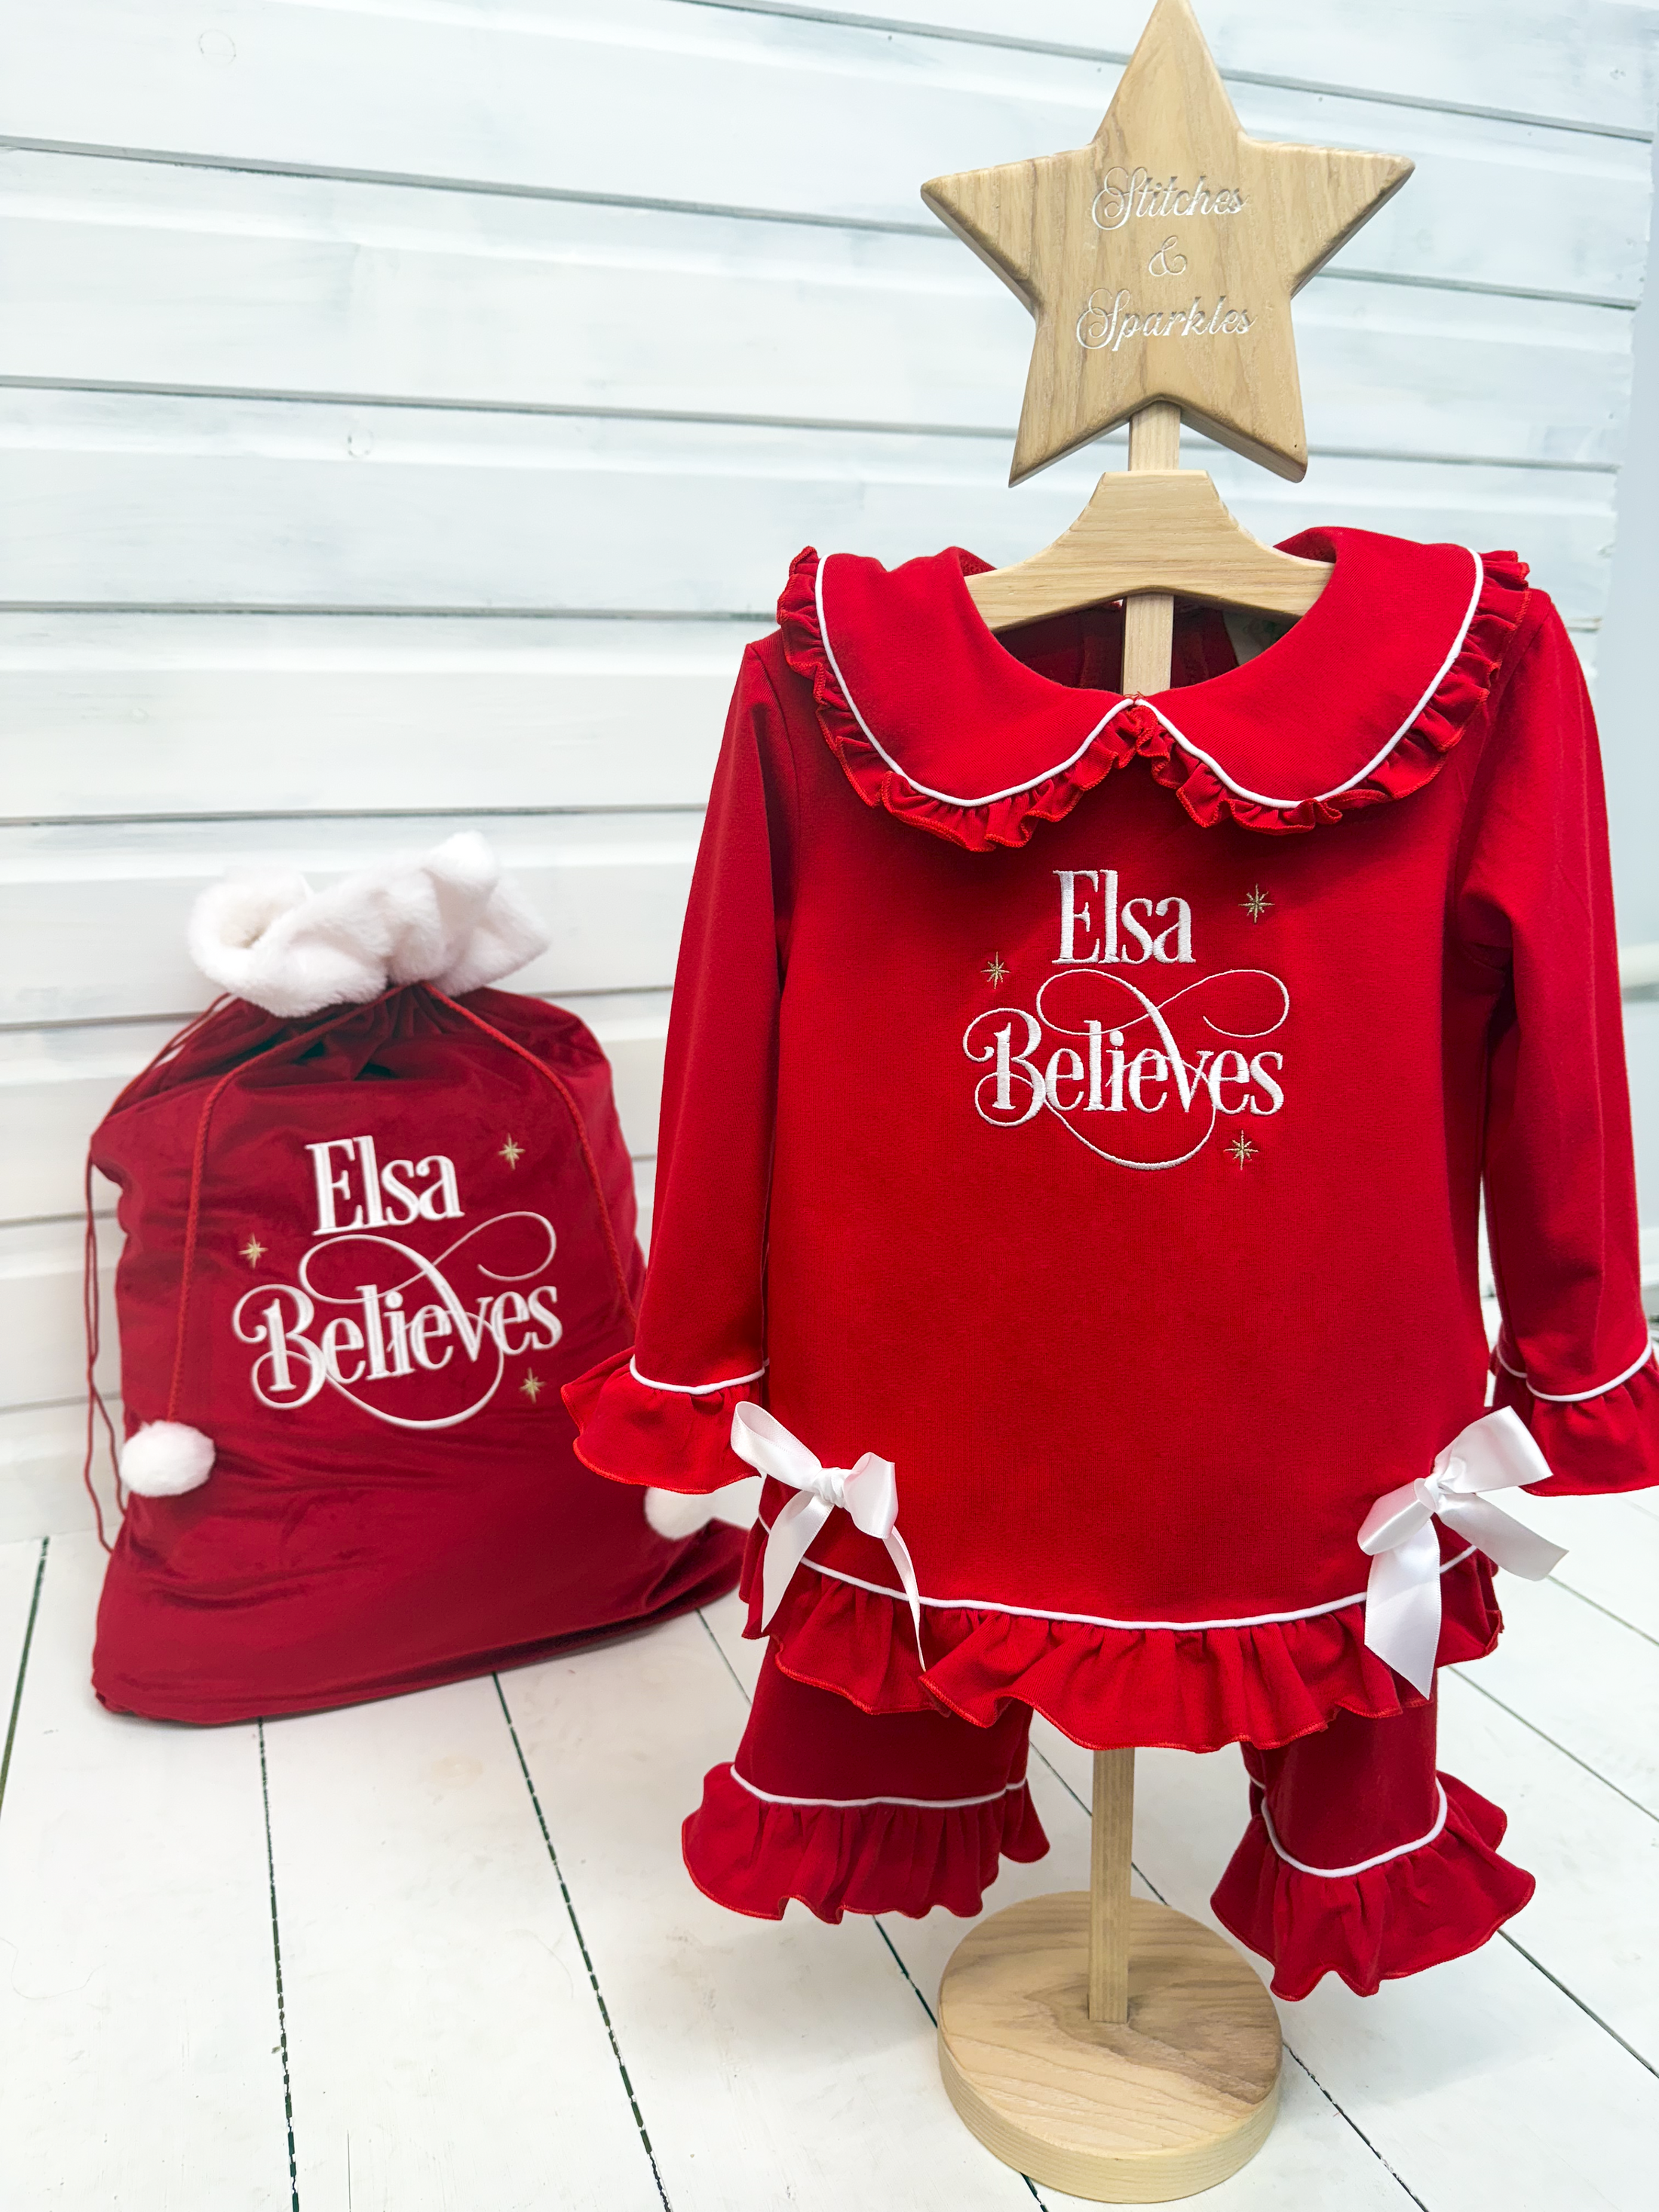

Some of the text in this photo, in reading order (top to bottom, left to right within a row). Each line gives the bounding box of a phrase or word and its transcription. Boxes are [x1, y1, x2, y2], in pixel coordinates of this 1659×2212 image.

[1092, 166, 1250, 231] Stitches
[1148, 235, 1188, 277] &
[1075, 287, 1258, 351] Sparkles
[1051, 869, 1197, 965] Elsa
[962, 968, 1290, 1170] Believes
[305, 1135, 465, 1235] Elsa
[232, 1211, 563, 1430] Believes
